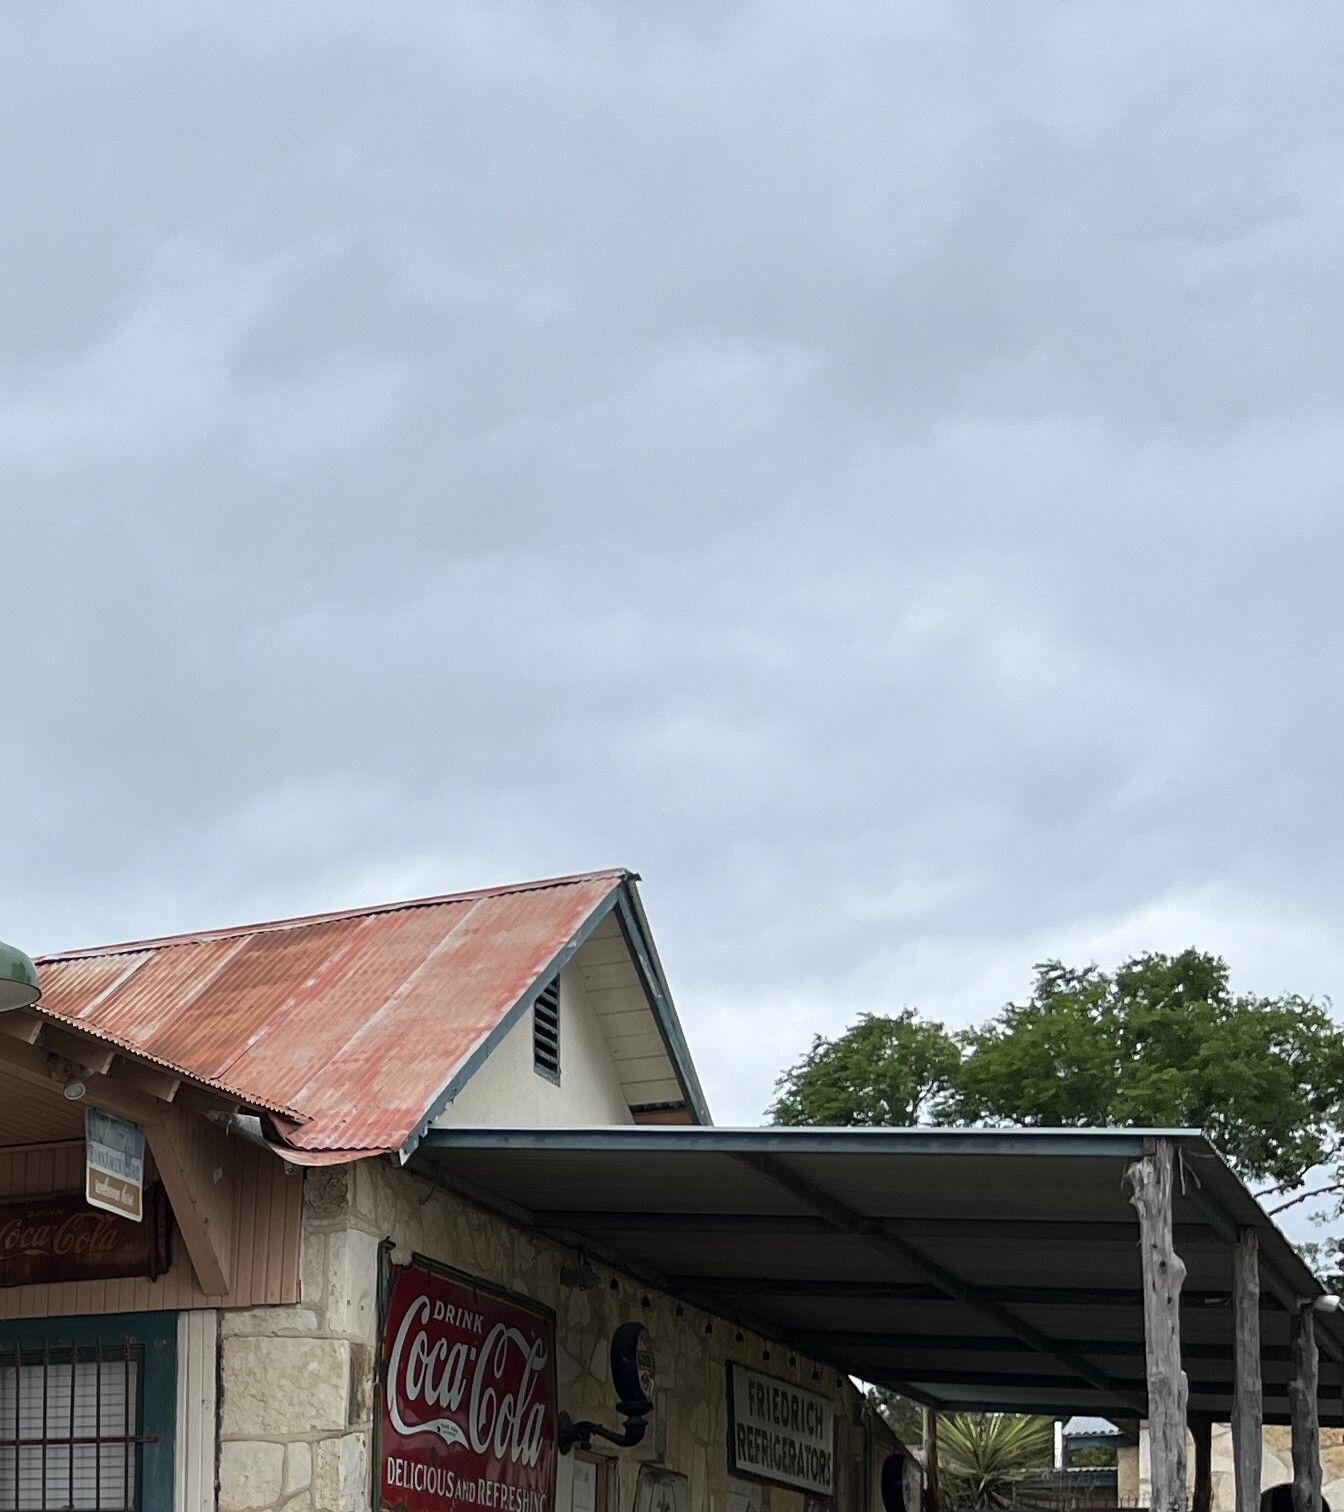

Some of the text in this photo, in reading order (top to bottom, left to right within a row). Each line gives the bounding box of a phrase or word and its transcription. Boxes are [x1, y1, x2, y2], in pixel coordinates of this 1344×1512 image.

[432, 1299, 485, 1335] DRINK
[387, 1295, 548, 1468] Coca-Cola
[748, 1380, 824, 1440] FRIEDRICH
[387, 1456, 455, 1499] DELICIOUS
[454, 1479, 477, 1503] AND
[736, 1422, 832, 1487] REFRIGERATORS
